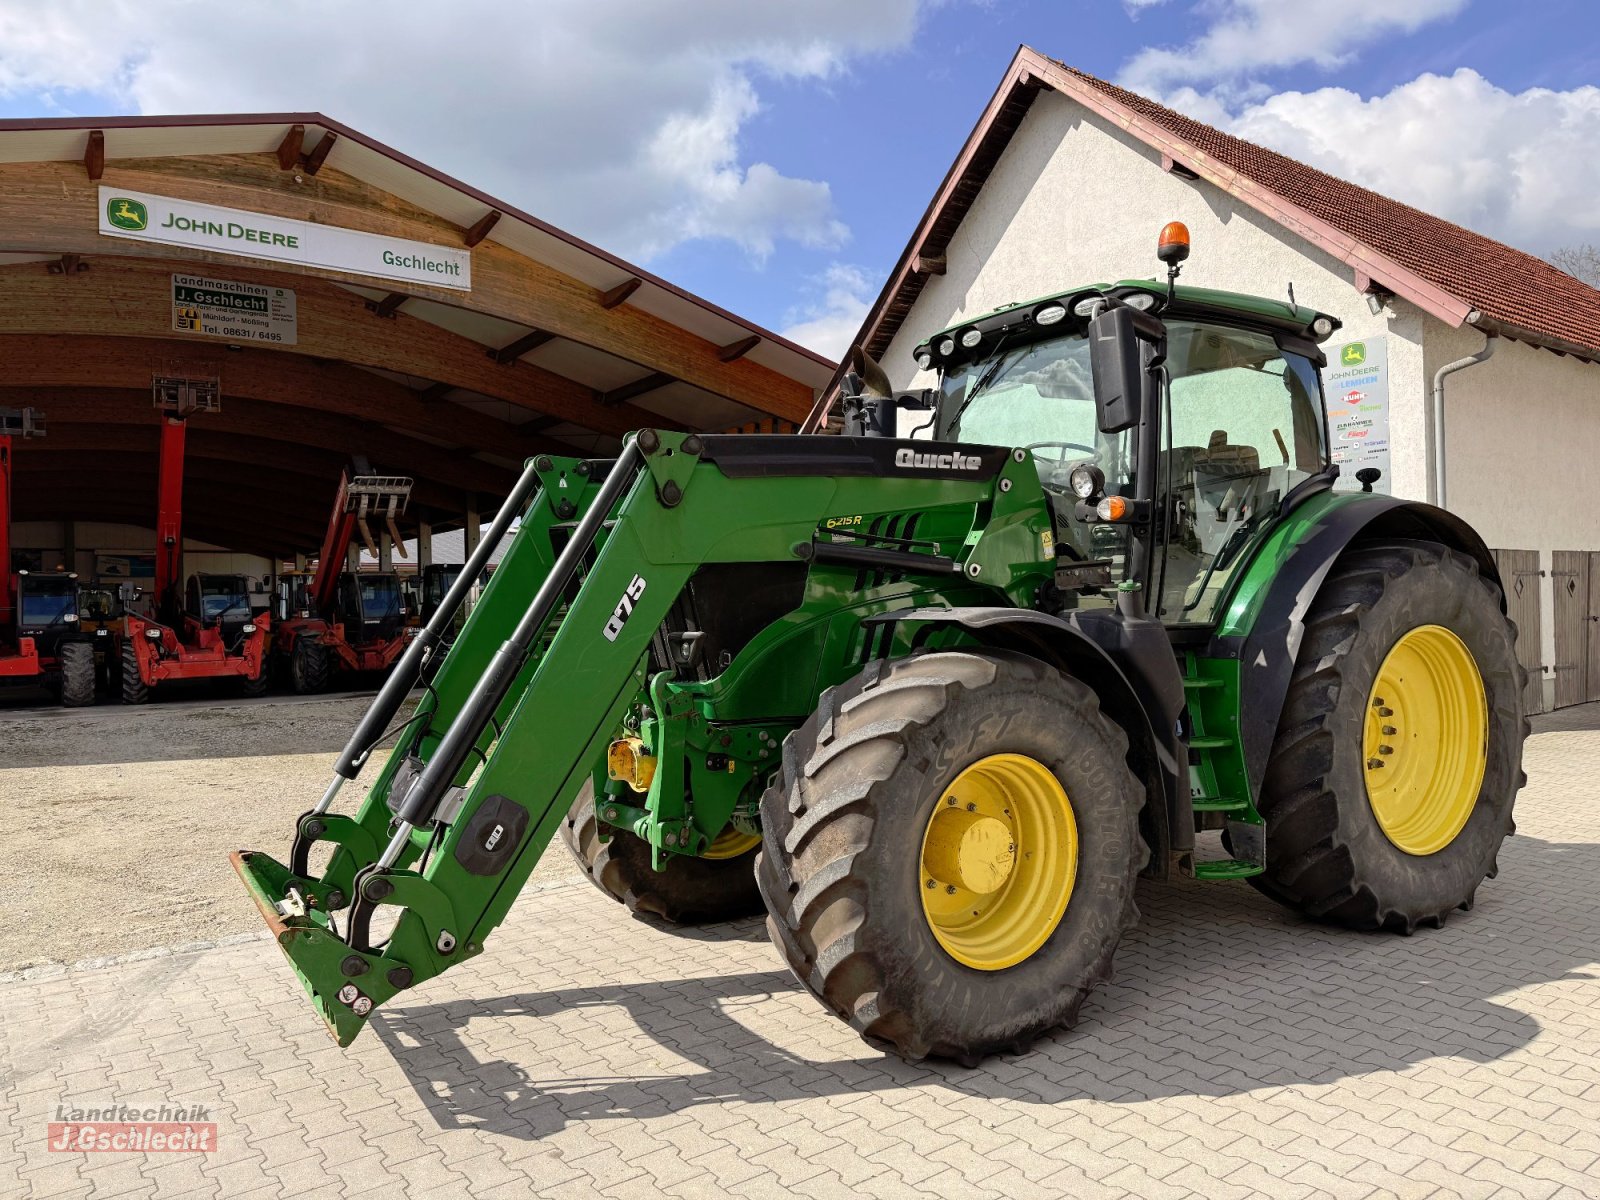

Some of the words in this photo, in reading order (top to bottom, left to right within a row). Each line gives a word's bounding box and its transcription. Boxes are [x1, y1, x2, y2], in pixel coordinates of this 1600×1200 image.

[161, 212, 223, 237] JOHN
[228, 223, 299, 249] DEERE
[382, 250, 461, 277] Gschlecht
[174, 275, 268, 296] Landmaschinen
[178, 289, 190, 301] J.
[194, 291, 266, 310] Gschlecht
[202, 313, 236, 323] Mühldorf
[202, 325, 220, 335] Tel.
[258, 331, 282, 341] 6495
[1328, 370, 1351, 381] JOHN
[1351, 365, 1380, 376] DEERE
[895, 448, 982, 471] Quicke
